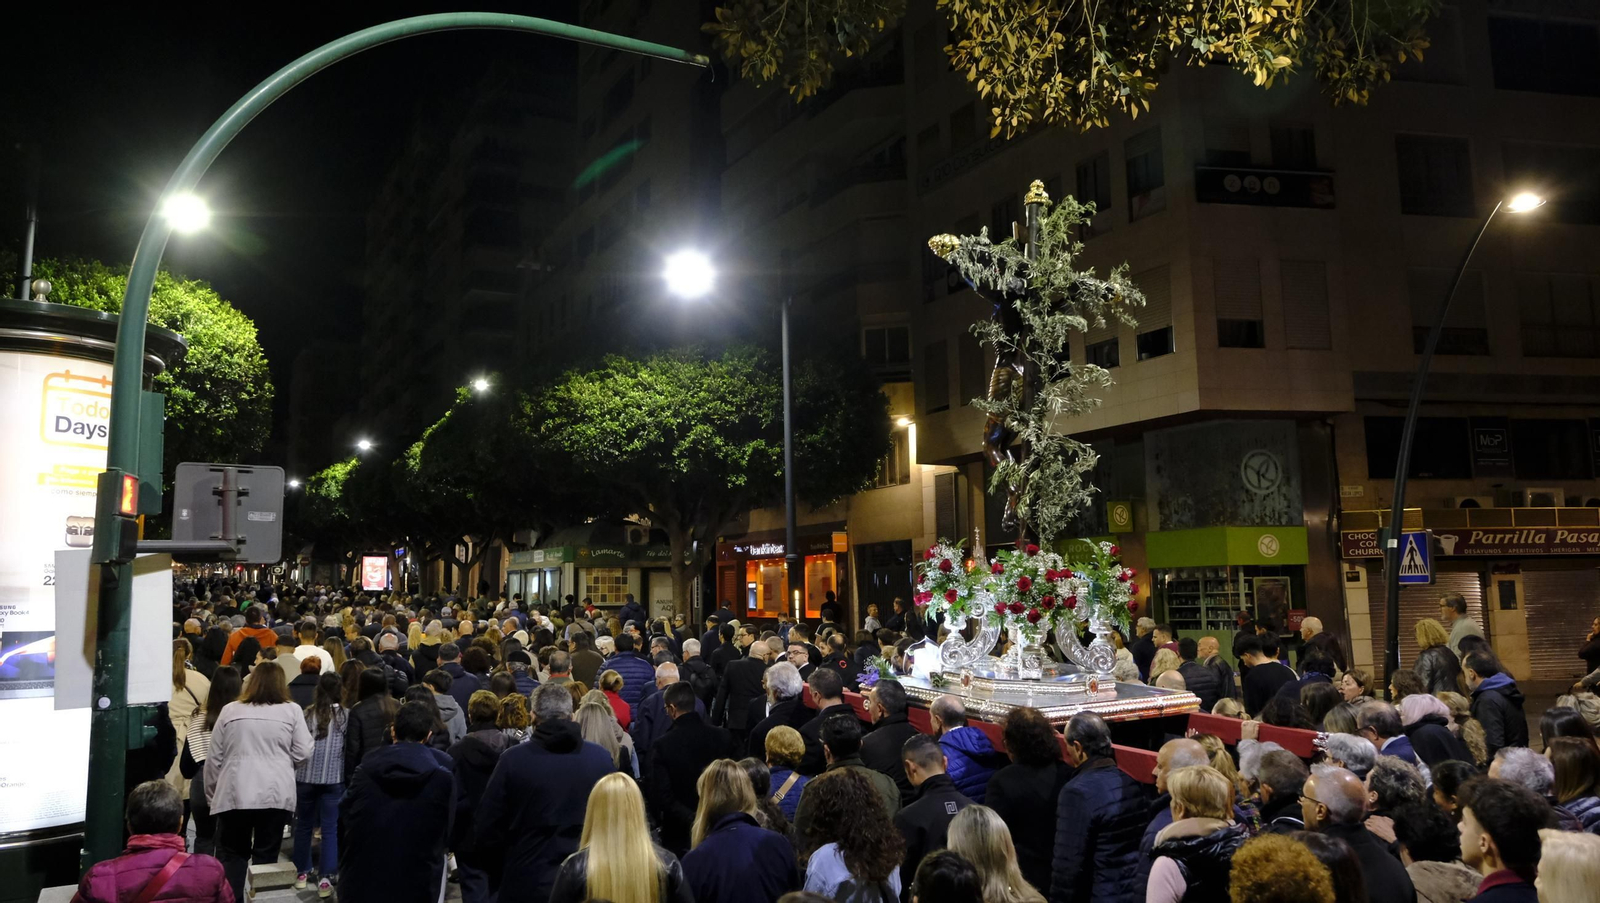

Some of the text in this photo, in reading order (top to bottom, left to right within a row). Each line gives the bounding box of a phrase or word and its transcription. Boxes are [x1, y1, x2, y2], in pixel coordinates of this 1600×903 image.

[57, 397, 109, 419] Todo
[55, 416, 107, 440] Days
[1469, 529, 1547, 544] Parrilla
